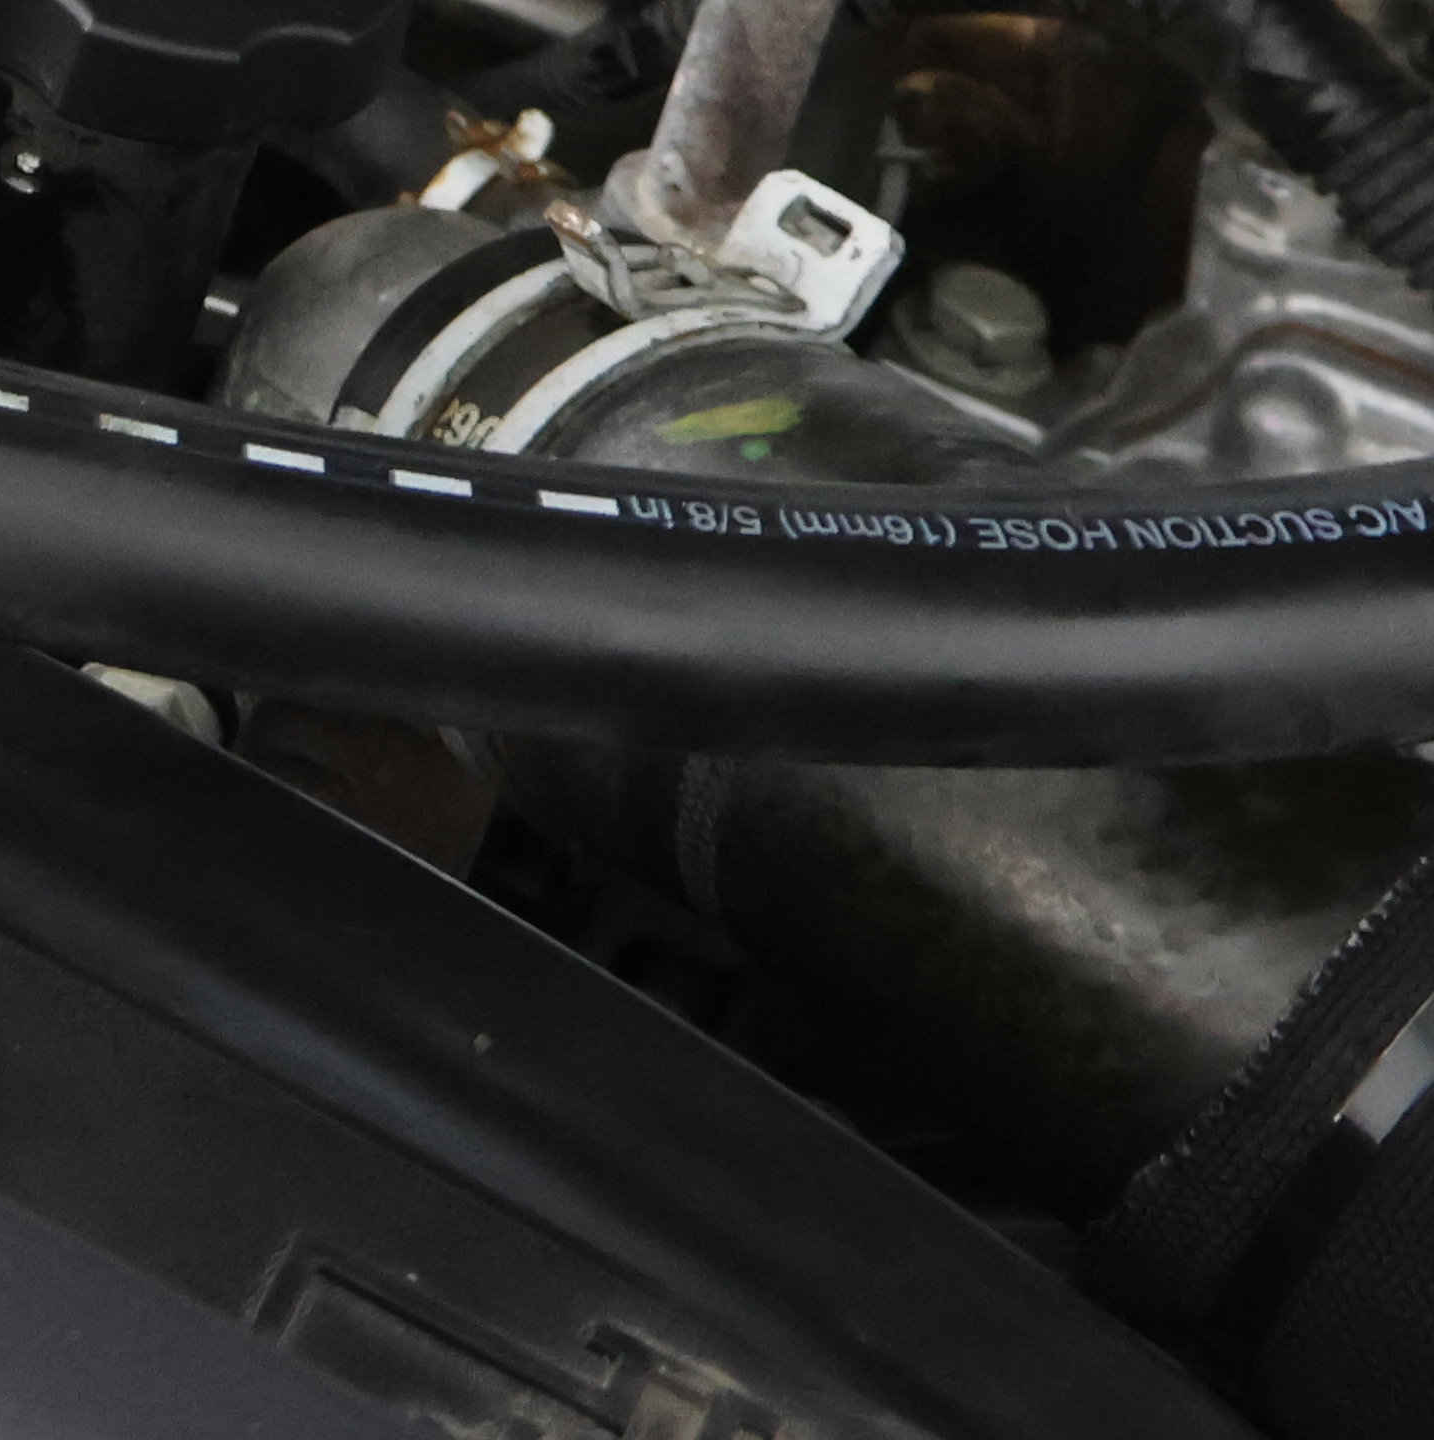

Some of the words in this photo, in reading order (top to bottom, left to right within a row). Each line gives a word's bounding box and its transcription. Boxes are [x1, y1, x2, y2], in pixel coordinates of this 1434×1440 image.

[628, 494, 675, 530] in
[779, 505, 957, 549] (16mm)
[1123, 507, 1344, 550] SUCTION
[1347, 498, 1427, 538] A/C
[970, 517, 1119, 551] HOSE
